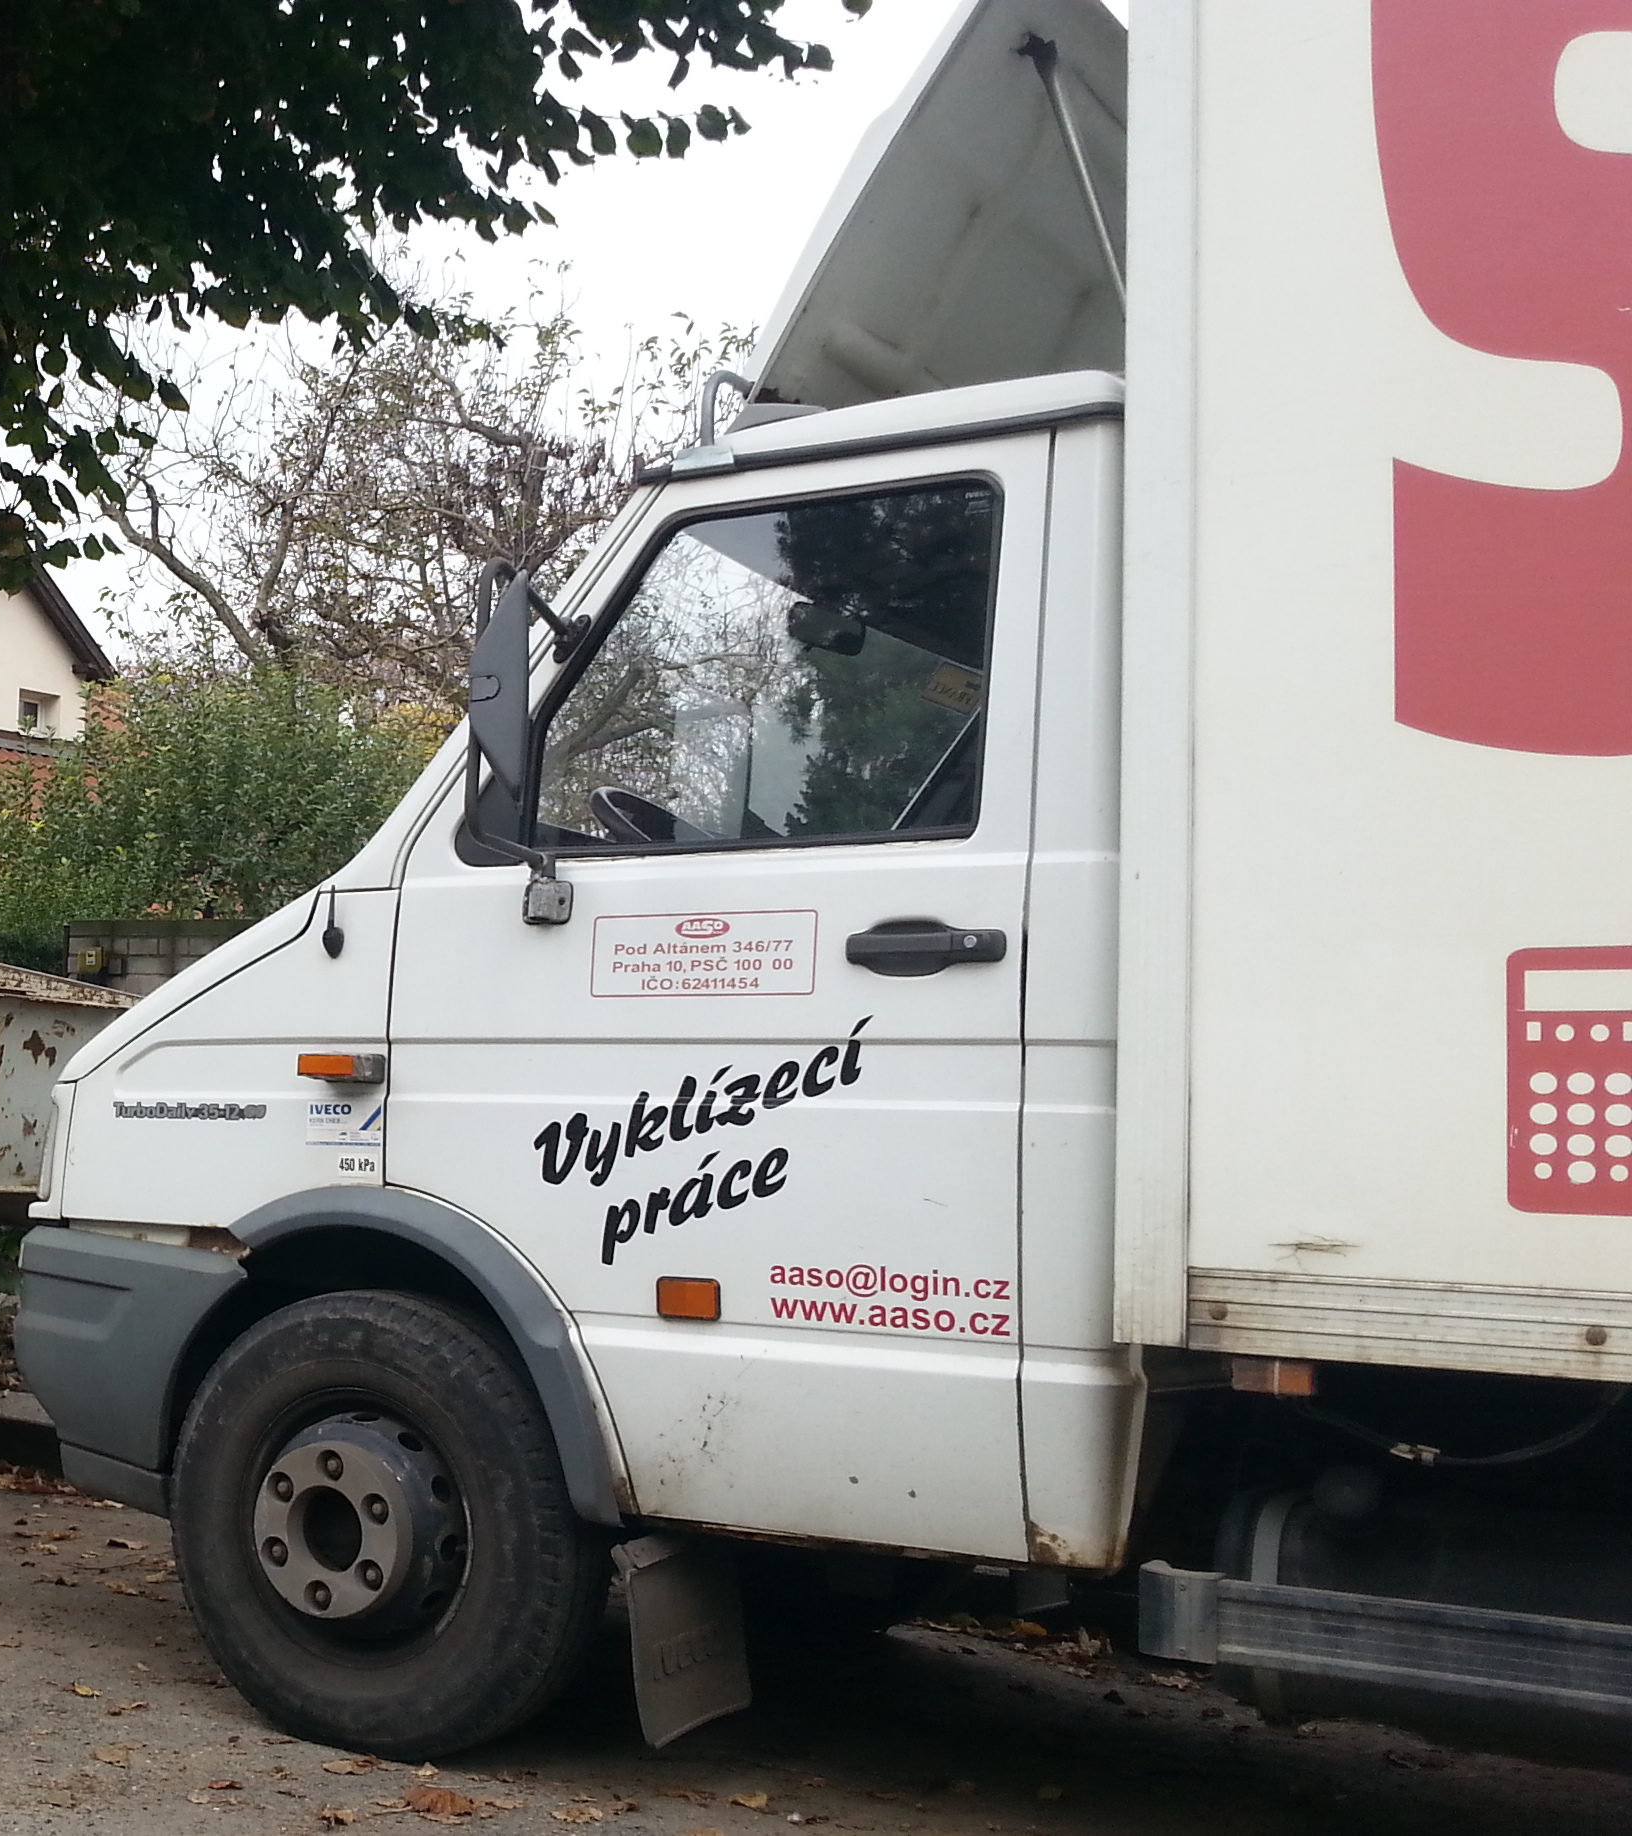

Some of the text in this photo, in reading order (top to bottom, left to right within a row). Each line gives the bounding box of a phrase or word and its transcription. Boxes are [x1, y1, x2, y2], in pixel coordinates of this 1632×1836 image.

[681, 920, 724, 934] AASO
[614, 940, 794, 956] Pod Altánem 346/77
[612, 956, 794, 974] Praha 10, PSČ 100 00
[641, 975, 760, 991] IČO:62411454
[310, 1104, 352, 1115] IVECO
[534, 1014, 874, 1187] Vyklízecí
[113, 1101, 195, 1120] TurboDaily
[339, 1157, 375, 1172] 450 kPa
[601, 1147, 789, 1266] práce
[769, 1264, 1011, 1302] aaso@login.cz
[770, 1297, 1011, 1337] www.aaso.cz
